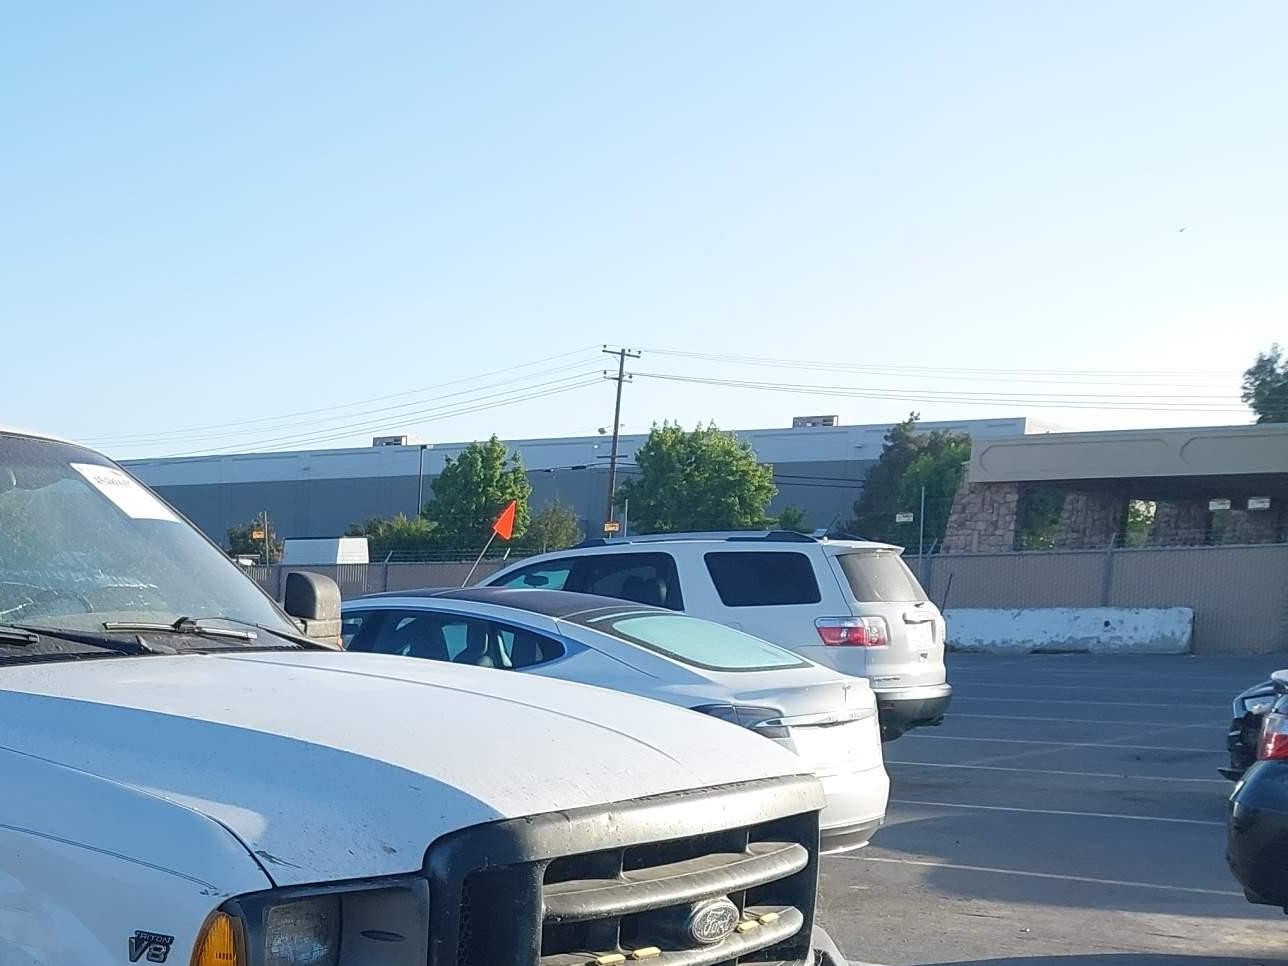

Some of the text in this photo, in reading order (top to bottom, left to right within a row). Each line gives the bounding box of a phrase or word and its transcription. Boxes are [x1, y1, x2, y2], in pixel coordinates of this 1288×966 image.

[700, 909, 732, 935] Ford
[129, 937, 167, 962] V8
[136, 931, 172, 944] TRITON
